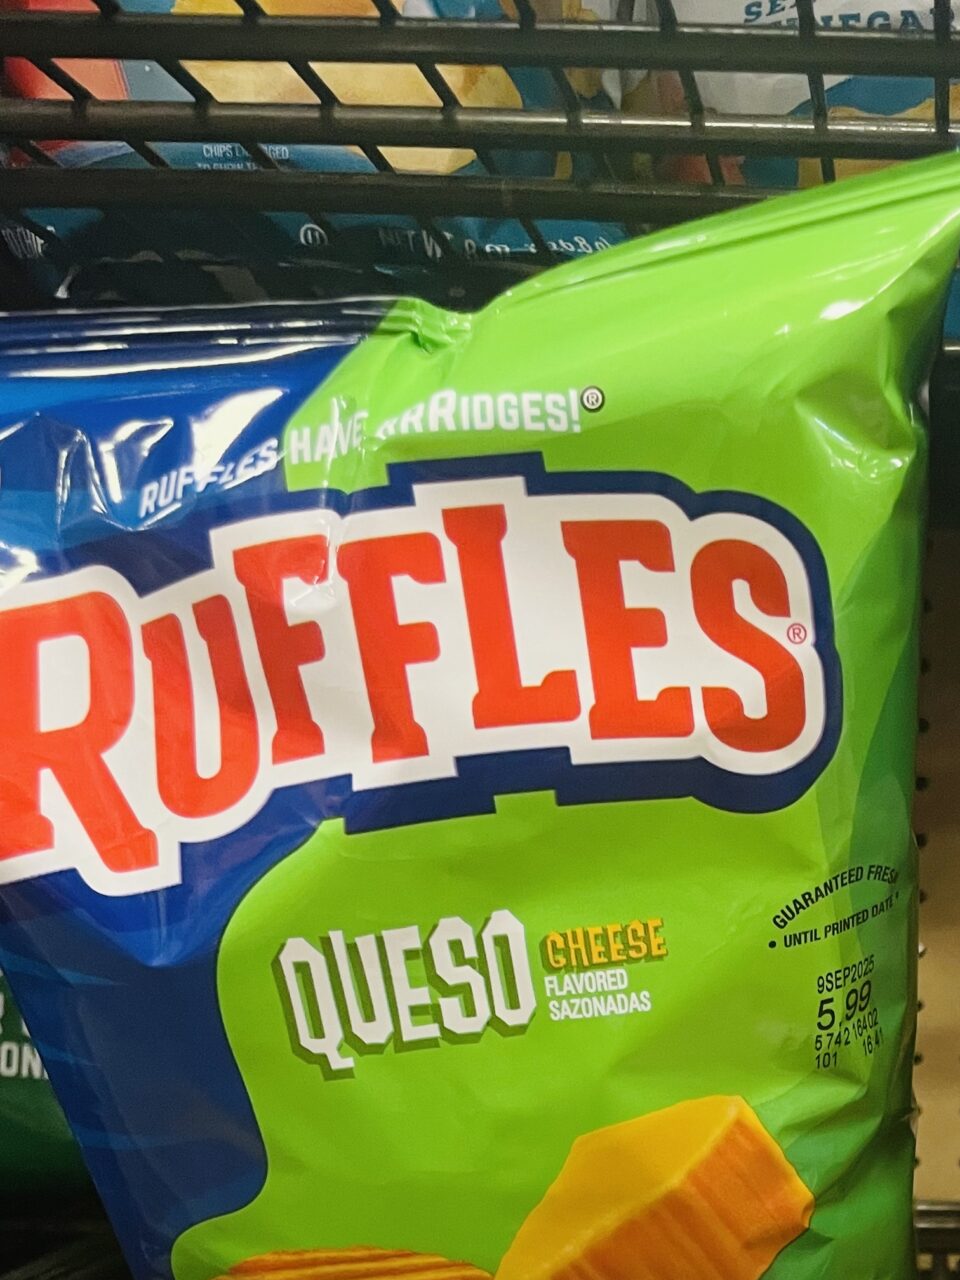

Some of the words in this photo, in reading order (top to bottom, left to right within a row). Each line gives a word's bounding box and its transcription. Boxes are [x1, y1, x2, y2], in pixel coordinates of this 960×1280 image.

[0, 503, 806, 875] RUFFLES
[772, 865, 864, 929] GUARANTEED
[543, 917, 668, 970] CHEESE
[784, 928, 821, 949] UNTIL
[824, 909, 869, 939] PRINTED
[277, 909, 536, 1070] QUESO
[544, 968, 628, 997] FLAVORED
[817, 954, 875, 994] 9SEP2025
[549, 991, 652, 1021] SAZONADAS
[817, 980, 871, 1031] 5.99
[815, 1051, 837, 1069] 101
